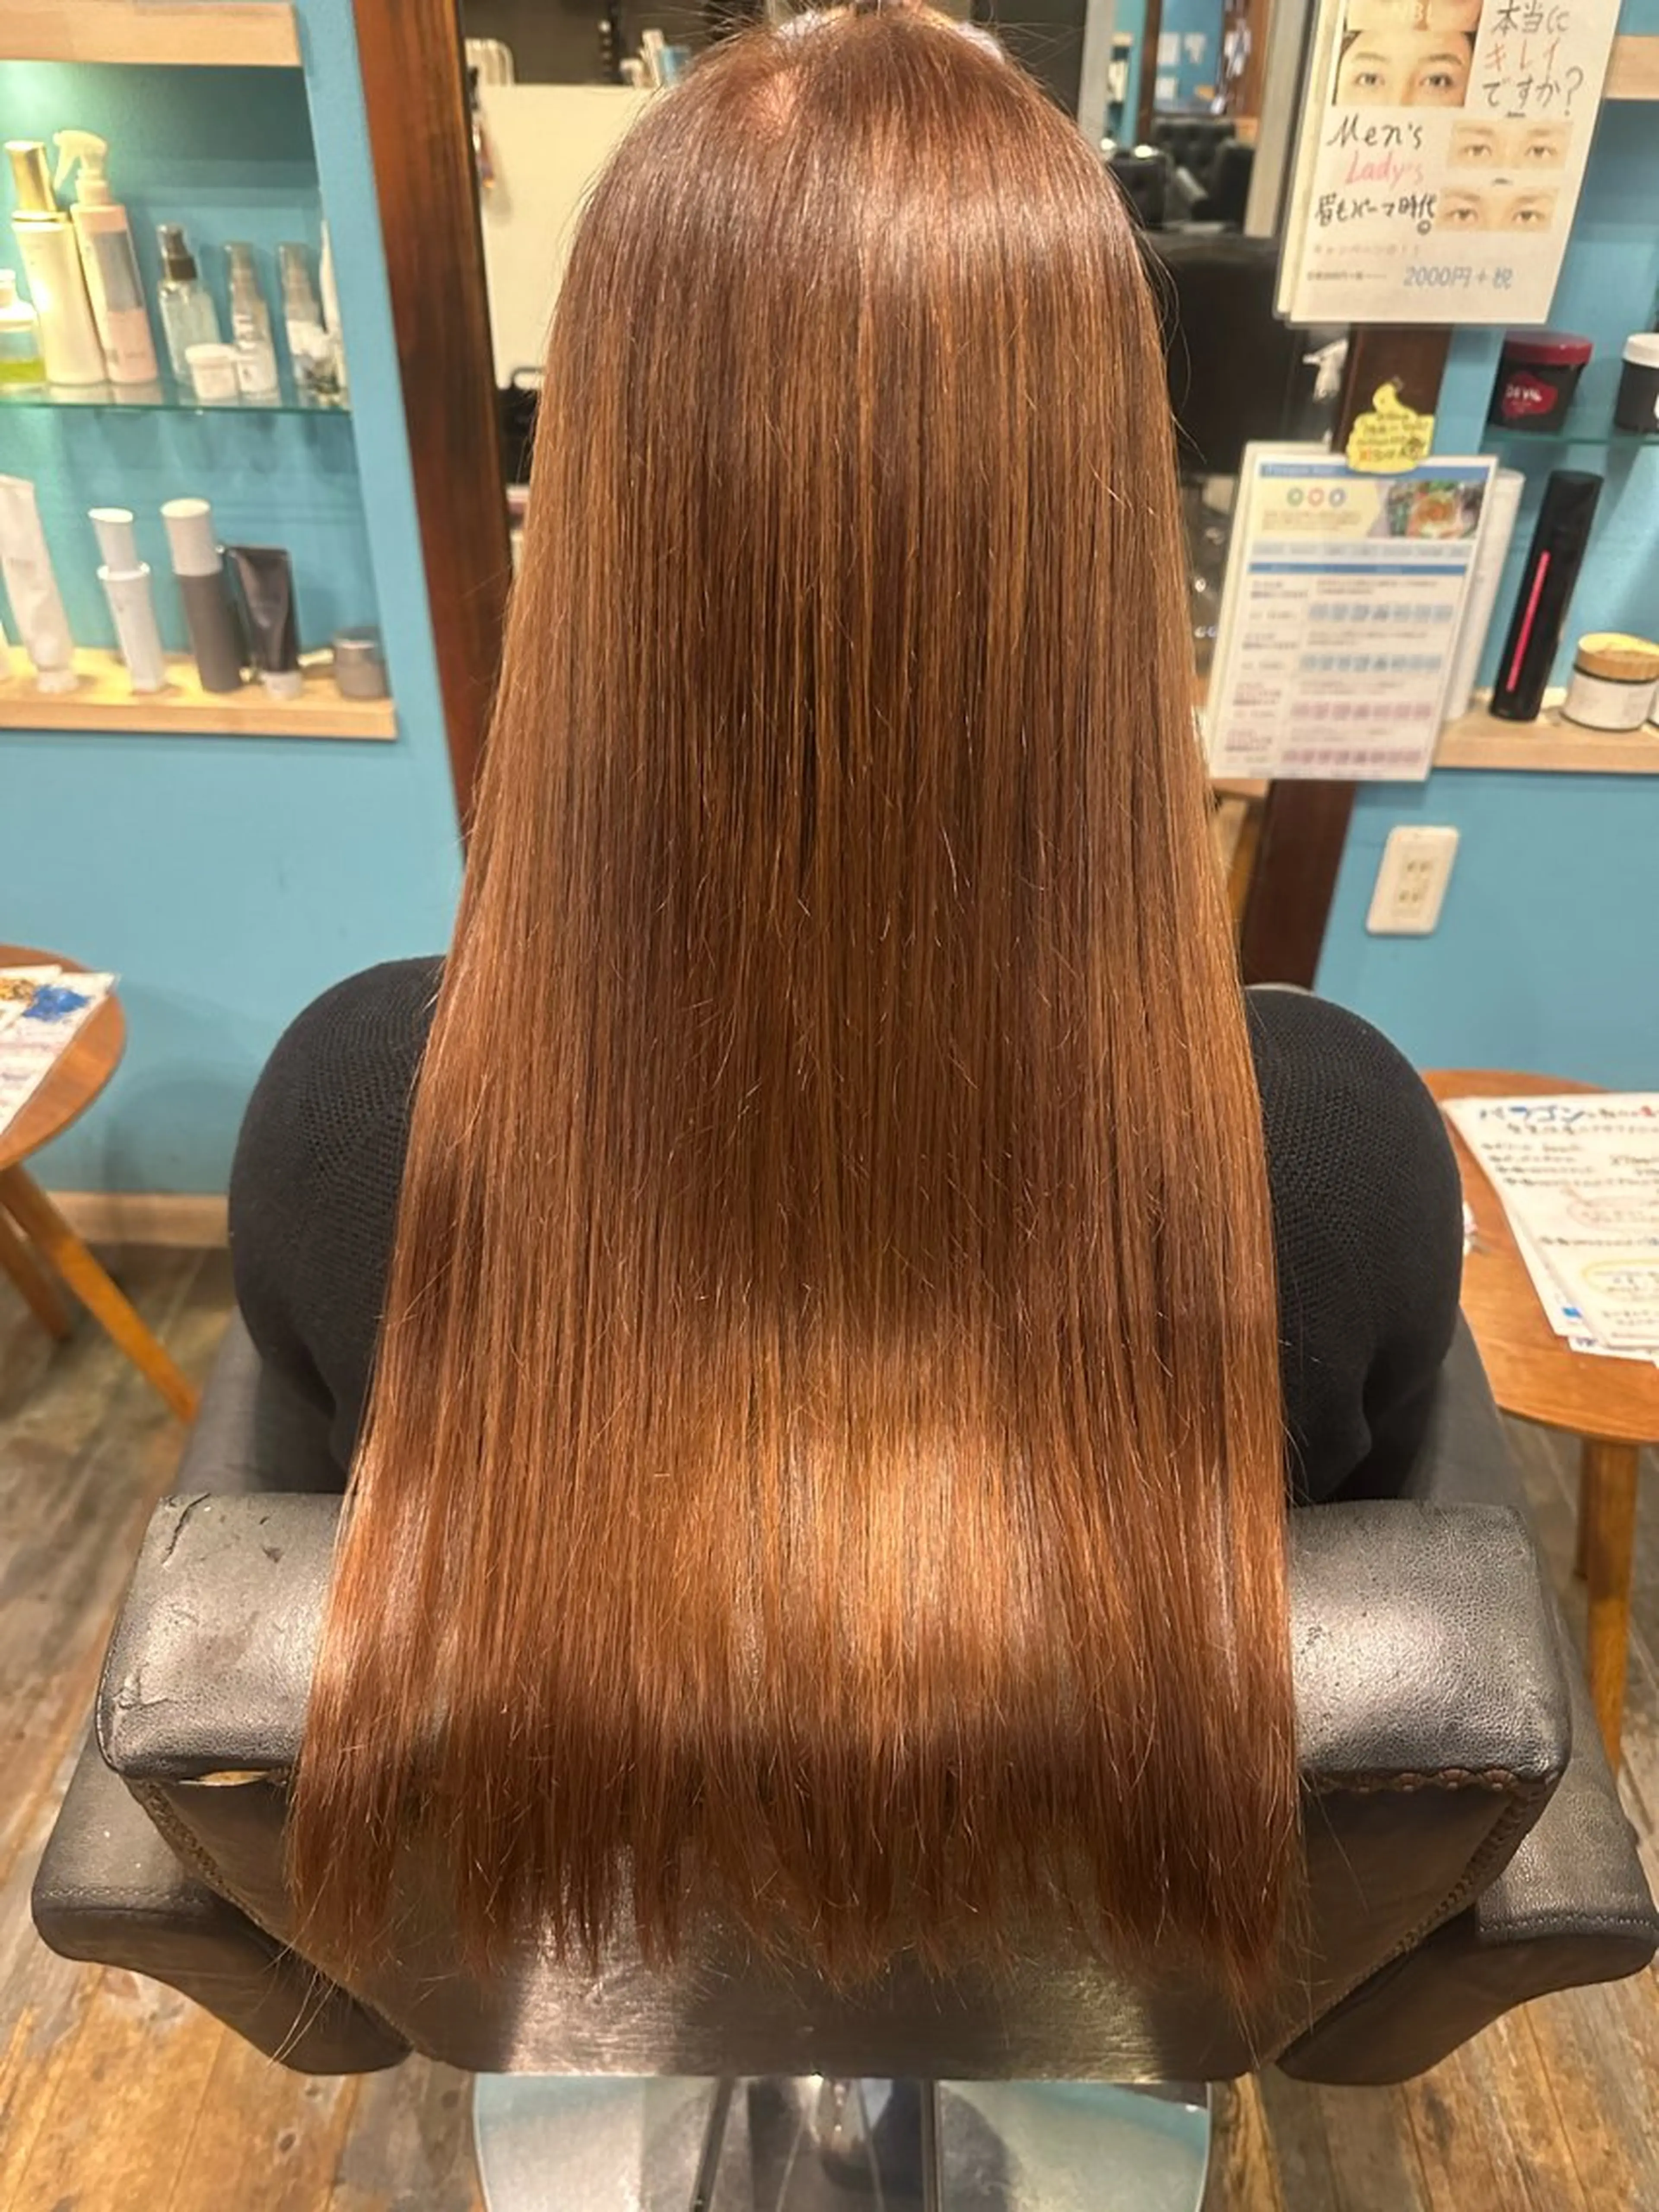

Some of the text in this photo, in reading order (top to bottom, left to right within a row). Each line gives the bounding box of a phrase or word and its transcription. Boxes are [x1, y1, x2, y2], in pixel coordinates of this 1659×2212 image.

[1490, 0, 1570, 37] 本当に
[1326, 113, 1423, 150] Men's
[1345, 151, 1424, 190] Lady's
